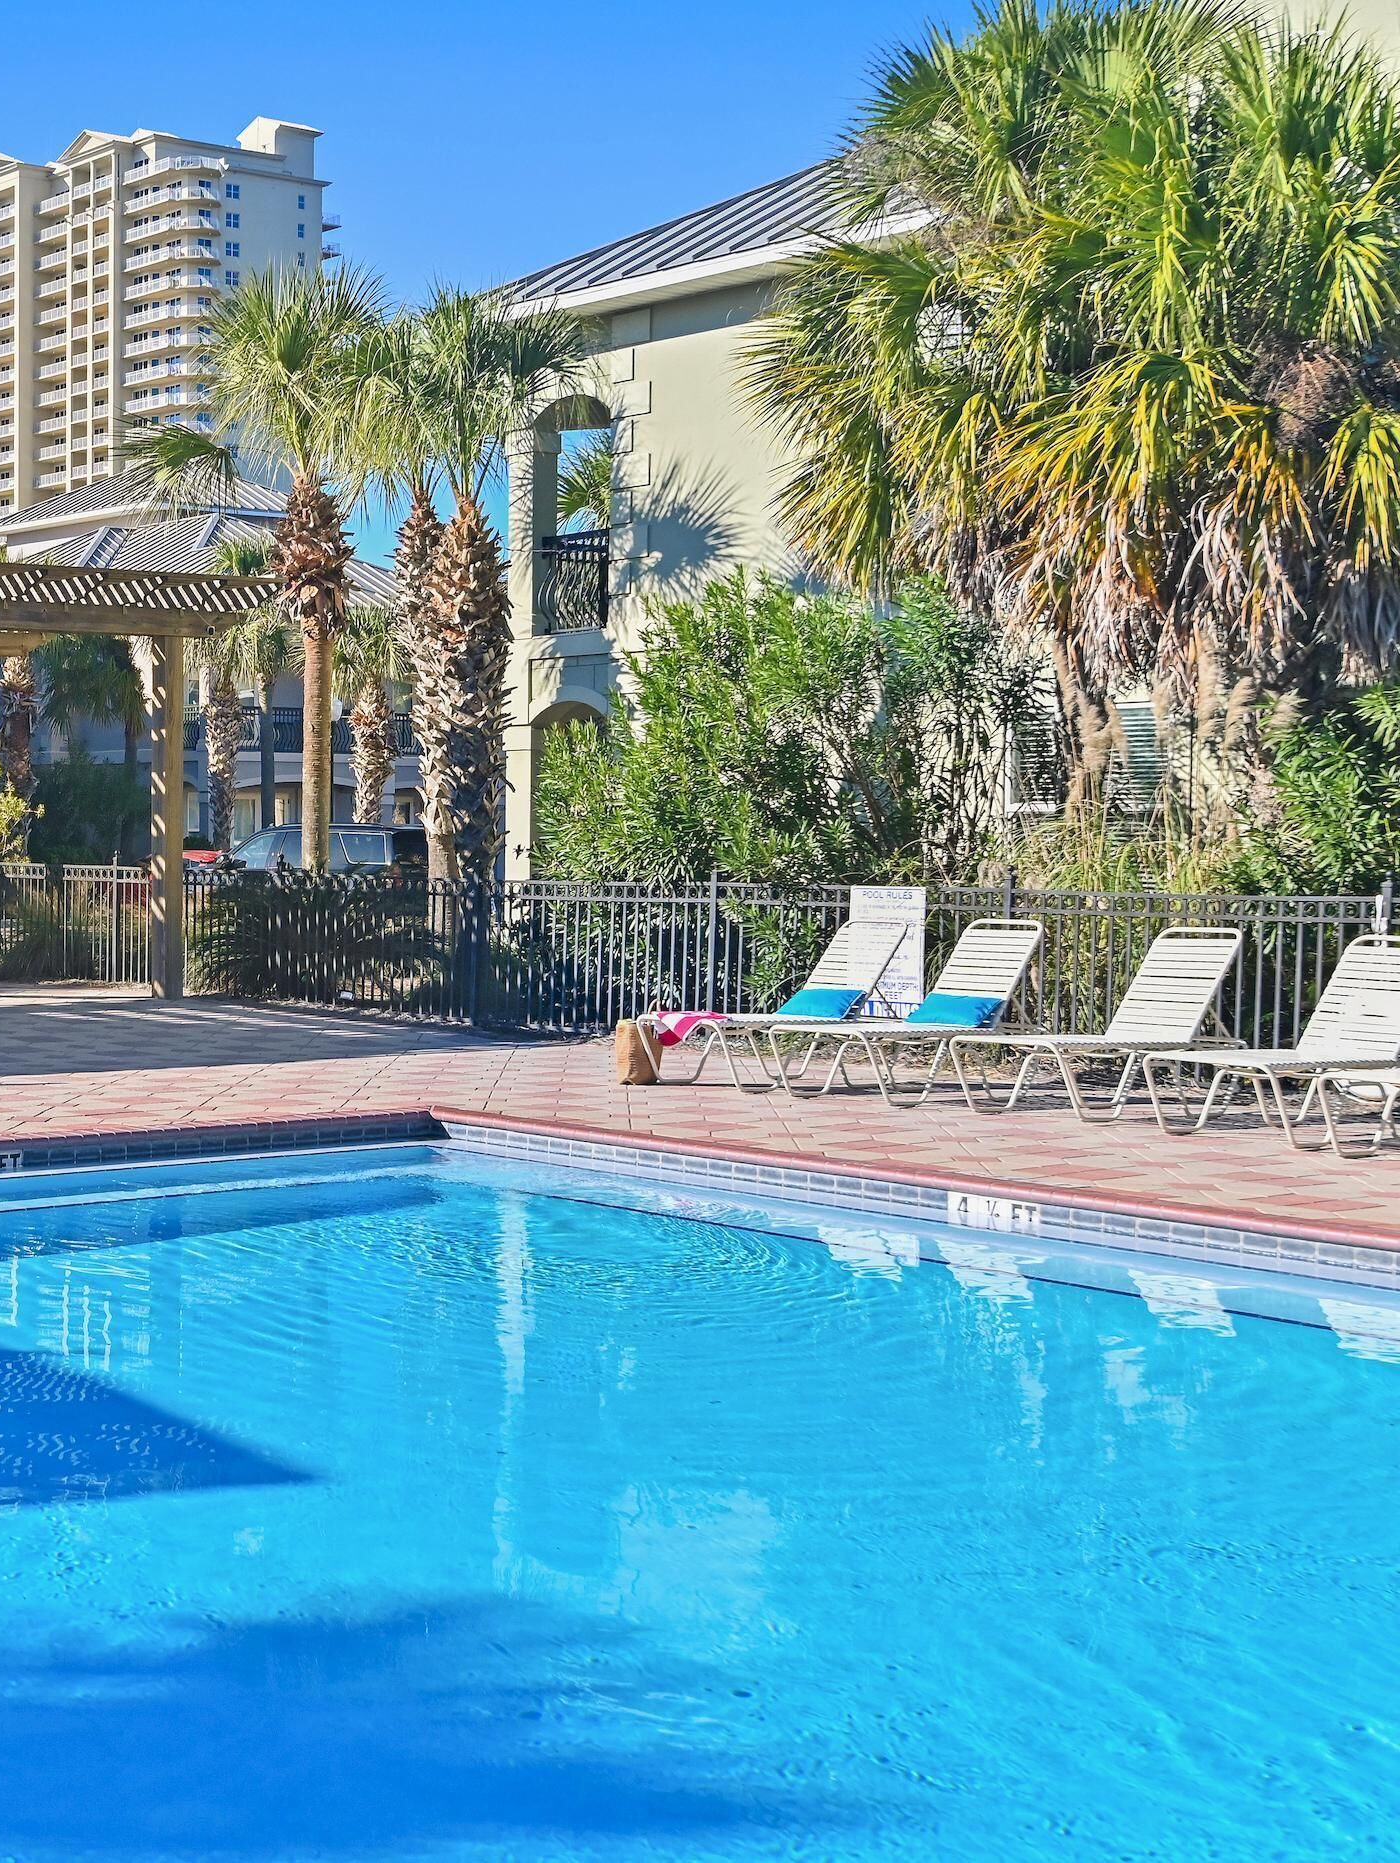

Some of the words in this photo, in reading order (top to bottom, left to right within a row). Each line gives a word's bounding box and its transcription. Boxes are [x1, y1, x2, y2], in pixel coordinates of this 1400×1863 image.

[863, 891, 884, 899] POOL
[887, 891, 913, 900] RULES
[957, 1196, 969, 1213] 4
[1011, 1203, 1037, 1222] FT
